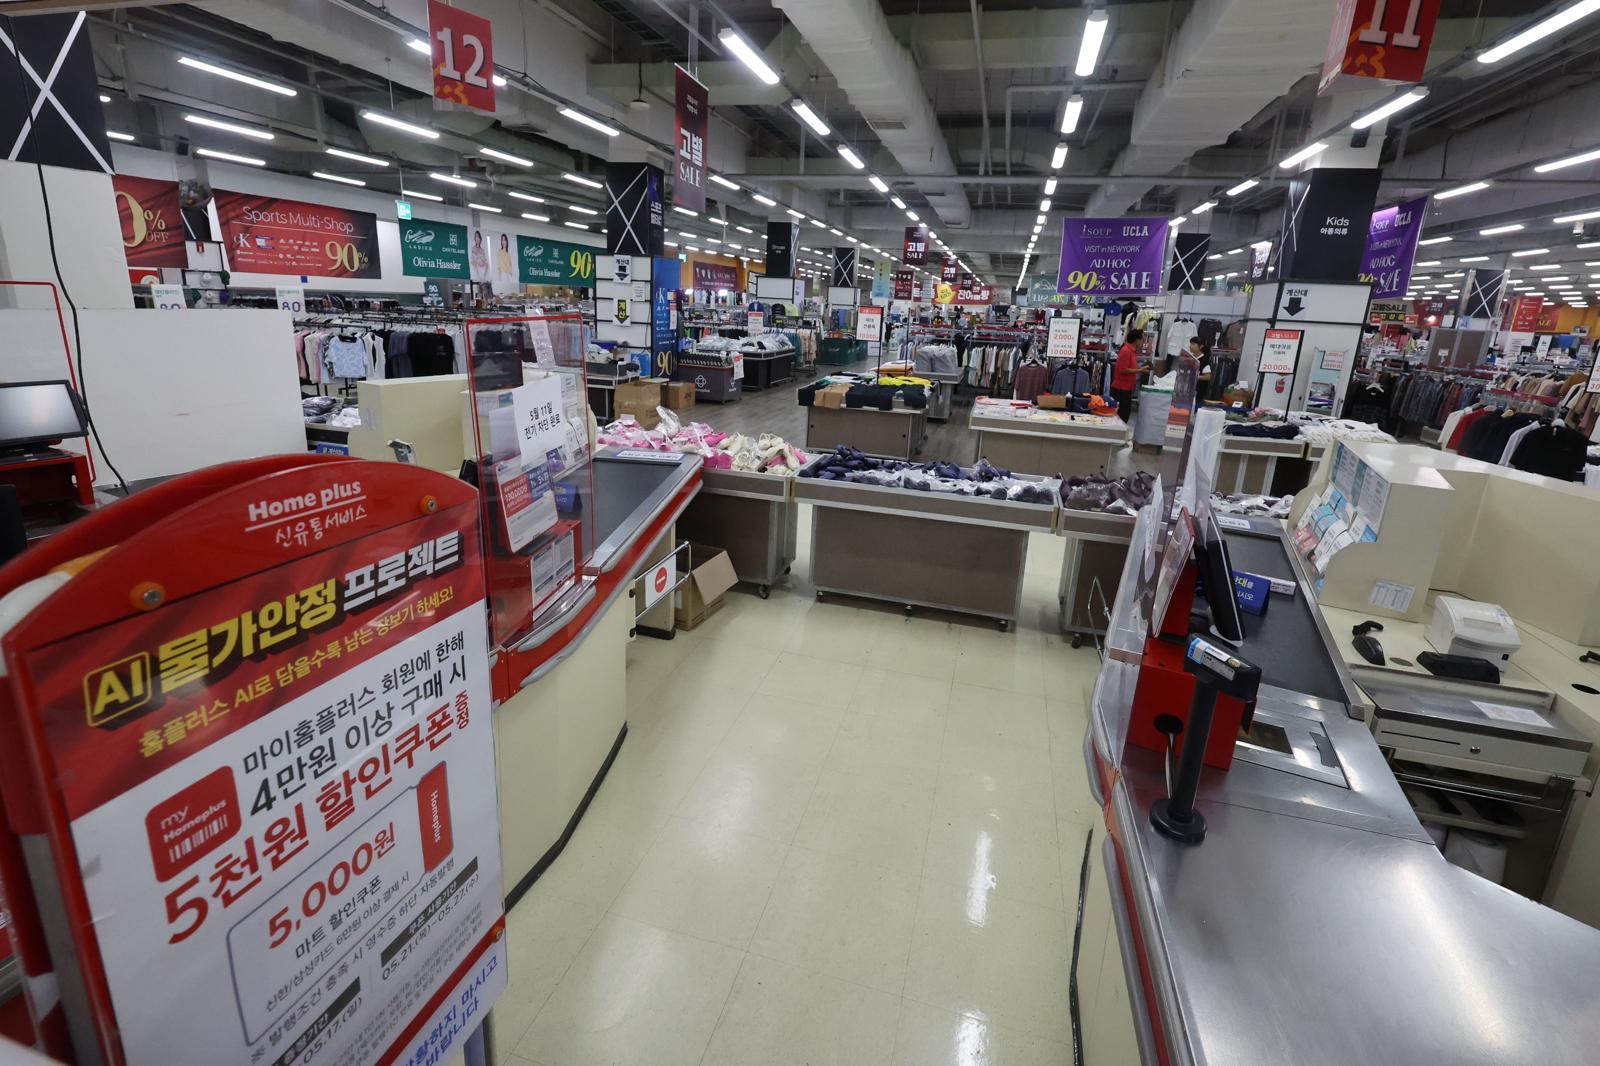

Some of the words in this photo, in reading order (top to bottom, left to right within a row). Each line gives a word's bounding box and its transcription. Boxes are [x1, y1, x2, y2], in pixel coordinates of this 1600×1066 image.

[1359, 0, 1420, 48] 11
[437, 27, 488, 88] 12
[680, 127, 703, 167] 고별
[680, 161, 701, 188] SALE
[145, 231, 169, 242] OFF
[242, 205, 289, 224] Sports
[288, 211, 355, 234] Multi-Shop
[1122, 225, 1149, 237] UCLA
[1326, 216, 1350, 226] Kids
[1394, 211, 1412, 227] UCLA
[325, 240, 369, 272] 90%
[412, 256, 436, 268] Olivia
[436, 258, 462, 270] Hassler
[907, 242, 926, 252] 고별
[1084, 244, 1100, 253] VISIT
[1089, 258, 1106, 269] AD
[1106, 258, 1131, 269] HOC
[1109, 271, 1152, 291] SALE
[541, 401, 552, 415] 11일
[247, 490, 317, 522] Home
[320, 481, 362, 508] plus
[1236, 590, 1254, 601] 시오
[93, 659, 145, 717] AI
[158, 577, 337, 695] 물가안정
[343, 530, 459, 612] 프로젝트
[139, 699, 231, 759] 홈플러스
[233, 674, 275, 709] AI로
[275, 638, 342, 689] 담을수록
[343, 628, 374, 652] 남는
[374, 603, 415, 638] 장보기
[416, 586, 454, 615] 하세요!
[242, 686, 377, 775] 마이홈플러스
[381, 649, 431, 695] 회원에
[435, 630, 465, 664] 한해
[454, 688, 470, 730] 증정
[249, 736, 338, 817] 4만원
[345, 700, 395, 750] 이상
[400, 669, 443, 716] 구매
[448, 655, 467, 684] 시
[160, 805, 189, 830] my
[163, 799, 227, 844] Homeplus
[164, 801, 310, 945] 5천원
[315, 701, 454, 832] 할인쿠폰
[430, 789, 443, 844] Homeplus
[268, 821, 396, 950] 5,000원
[295, 926, 327, 959] 마트
[328, 874, 383, 931] 할인쿠폰
[336, 915, 362, 946] 6만원
[362, 899, 381, 920] 이상
[400, 871, 409, 886] 시
[353, 946, 363, 965] 시
[399, 893, 418, 917] 하단
[461, 954, 498, 1005] 마시고
[424, 996, 479, 1066] 바랍니다
